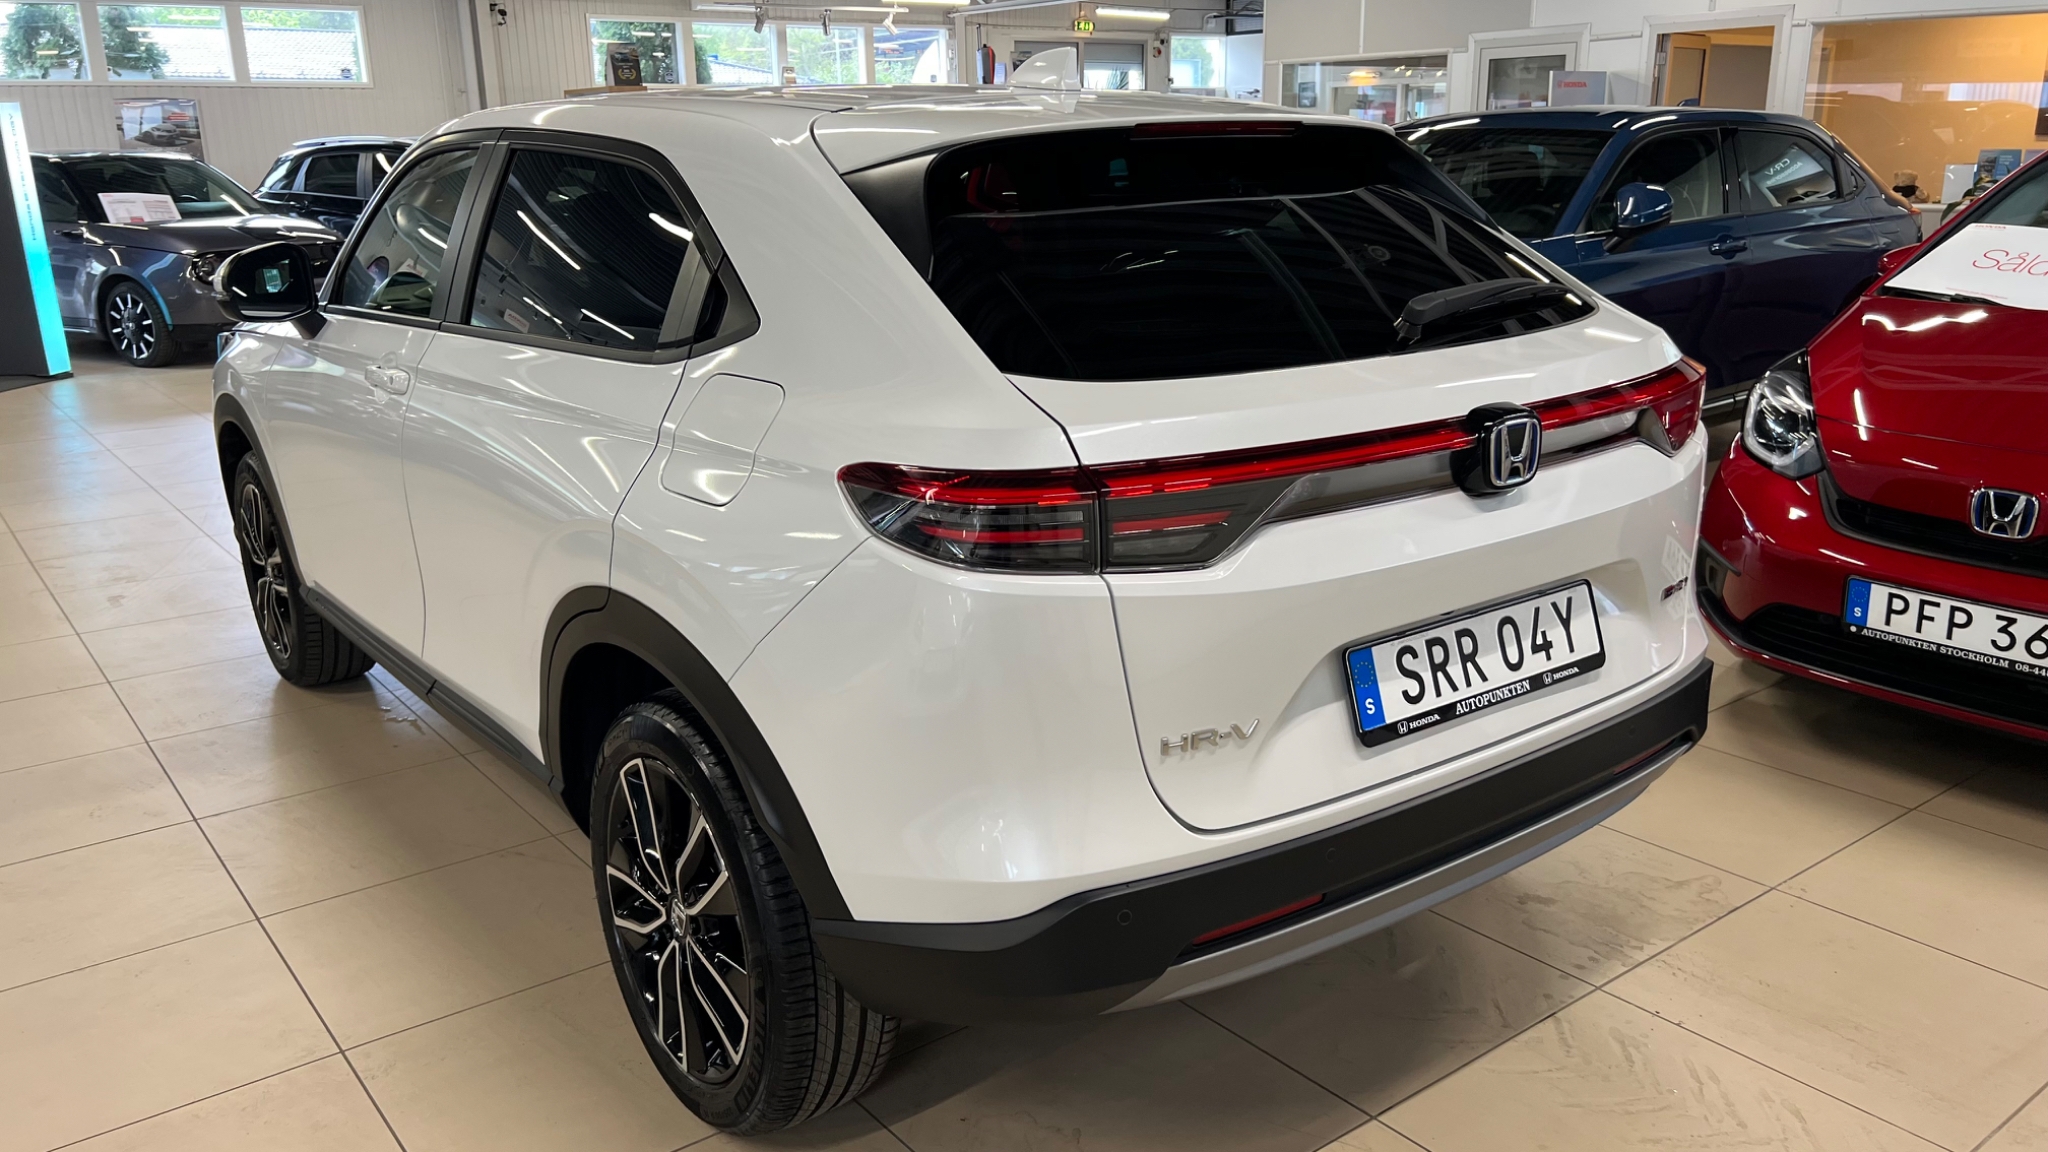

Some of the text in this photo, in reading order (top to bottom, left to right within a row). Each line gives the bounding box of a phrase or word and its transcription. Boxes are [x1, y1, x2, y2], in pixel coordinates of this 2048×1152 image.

[1854, 607, 1862, 617] S
[1884, 592, 1973, 641] PFP
[1396, 596, 1575, 705] SRR 04Y
[1861, 628, 2048, 678] AUTOPUNKTEN STOCKHOLM 08-44
[1553, 666, 1580, 680] HONDA
[1365, 698, 1375, 715] S
[1455, 679, 1531, 715] AUTOPUNKTEN
[1160, 718, 1260, 756] HR-V
[1409, 713, 1441, 729] HONDA
